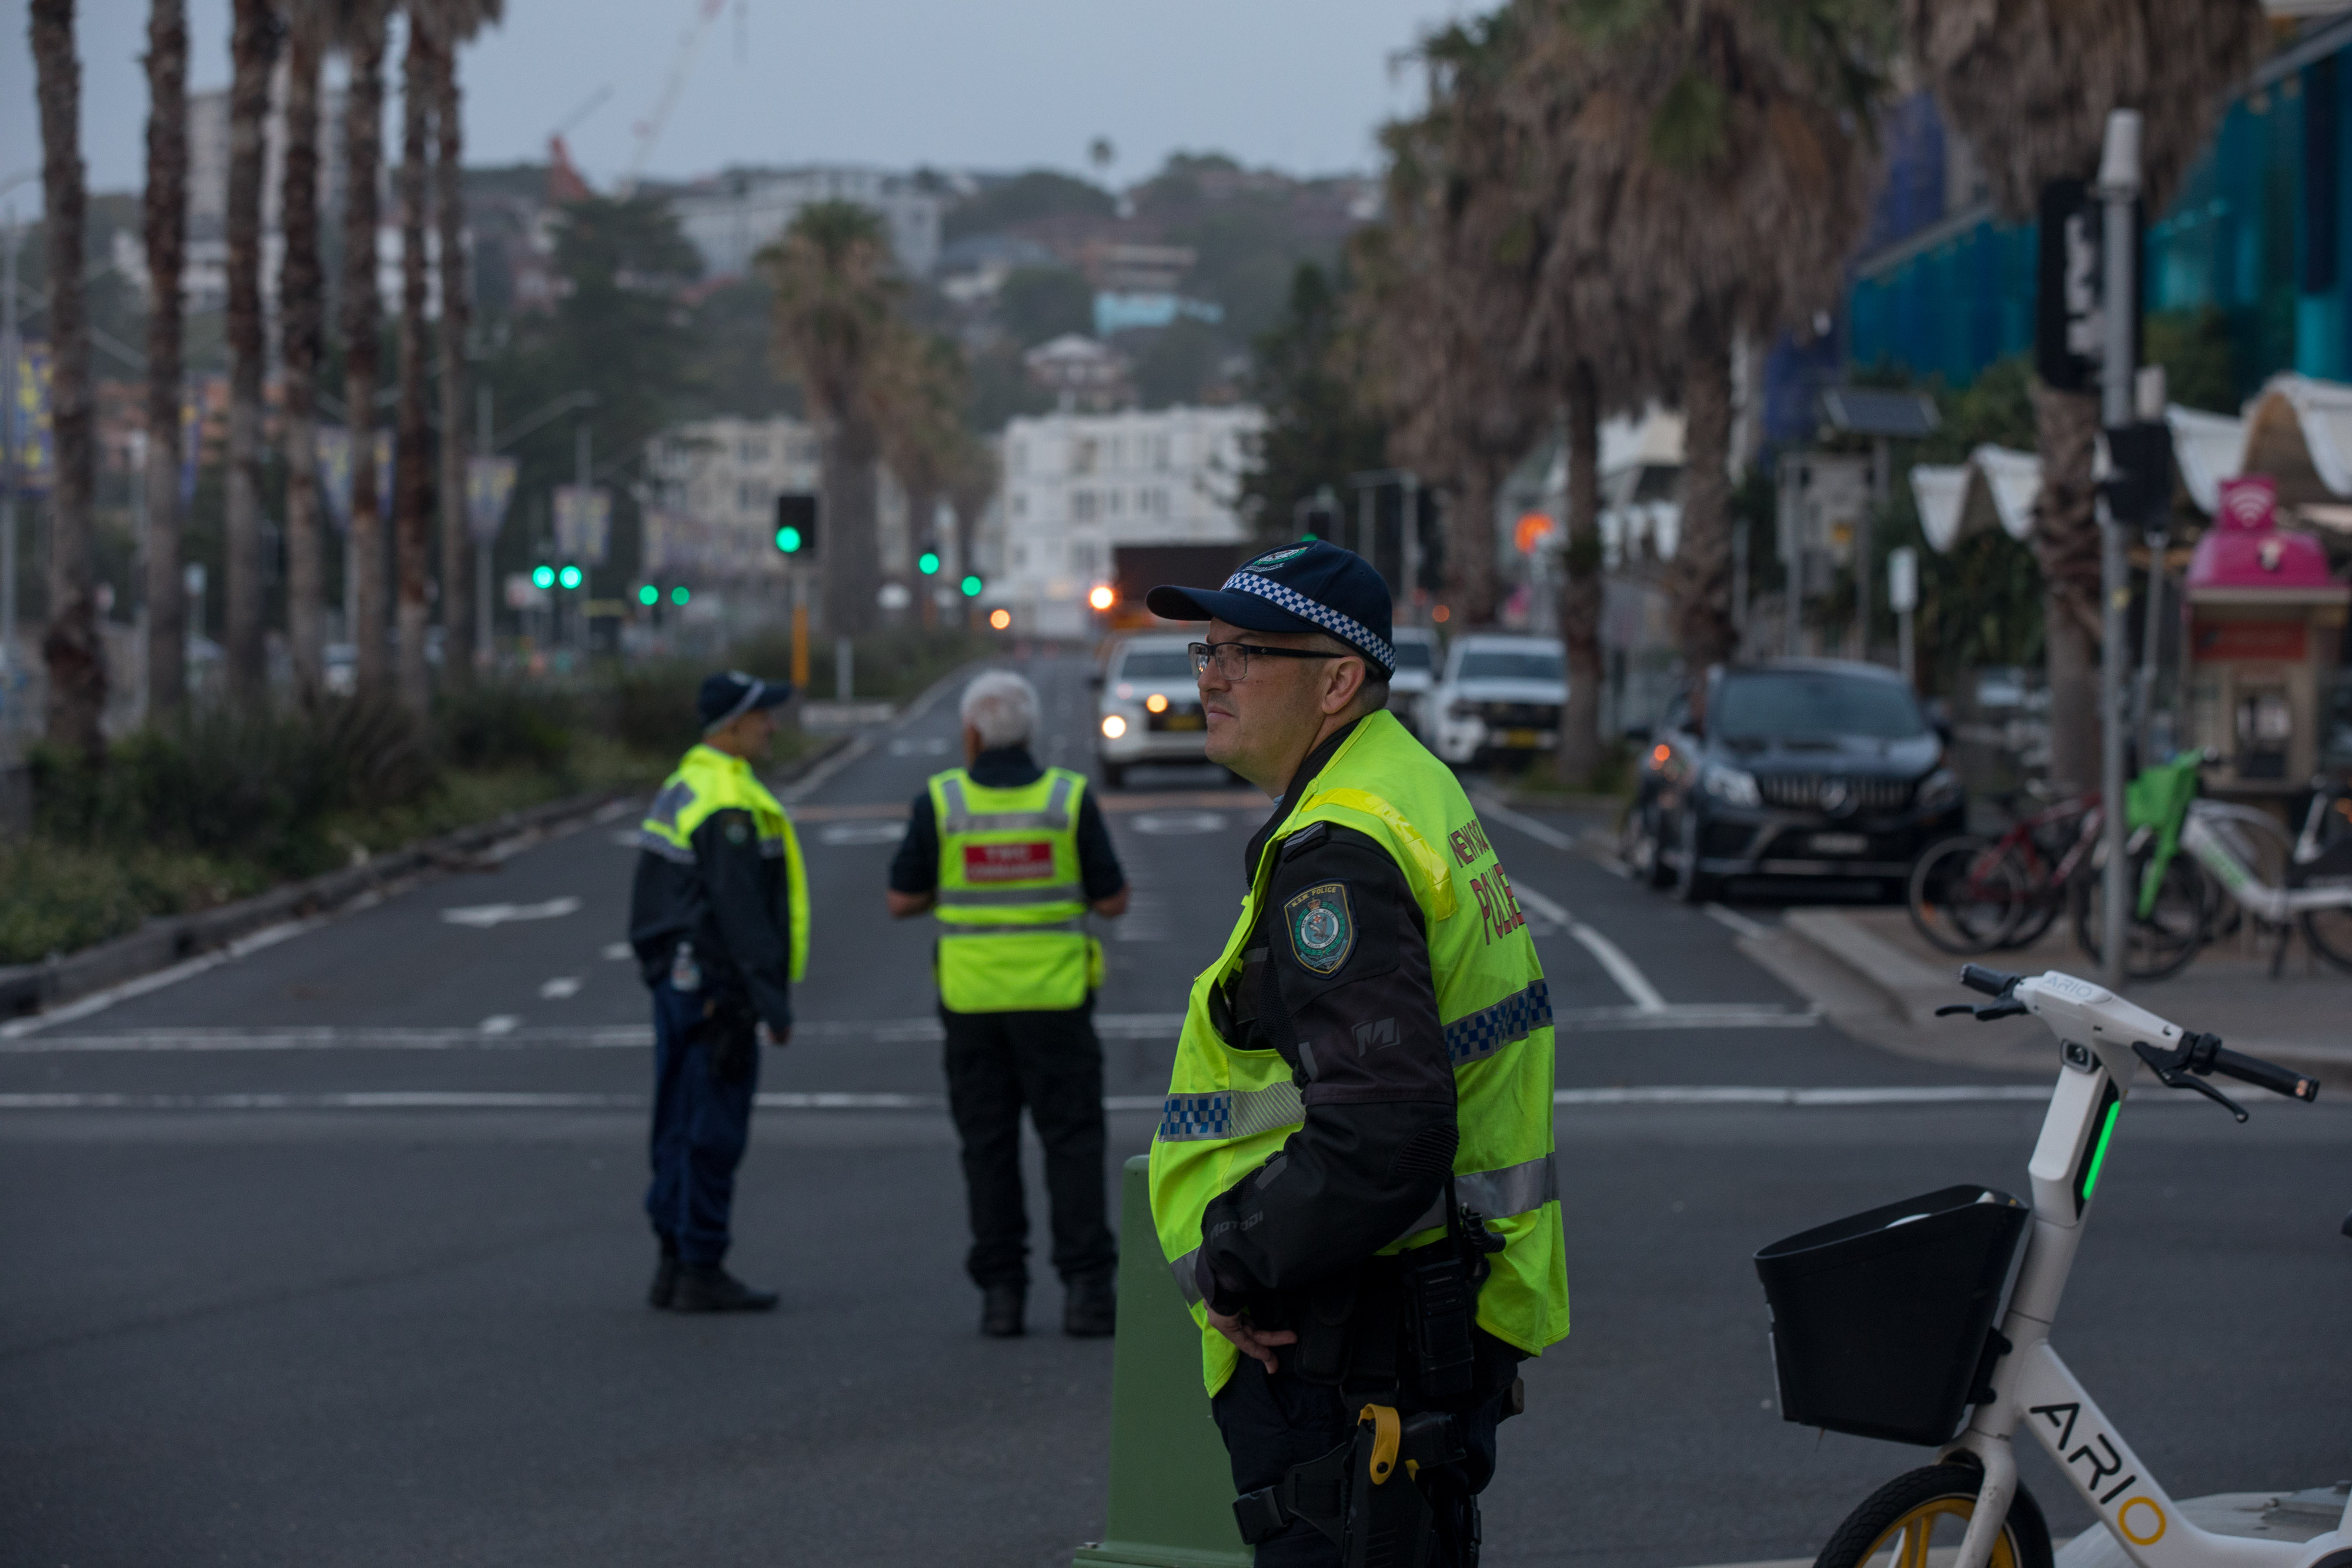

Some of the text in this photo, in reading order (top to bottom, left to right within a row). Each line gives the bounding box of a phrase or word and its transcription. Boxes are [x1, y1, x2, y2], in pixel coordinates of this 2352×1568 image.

[1312, 887, 1337, 895] POLICE
[2043, 975, 2092, 998] ARIO
[2029, 1402, 2166, 1545] ARIO
